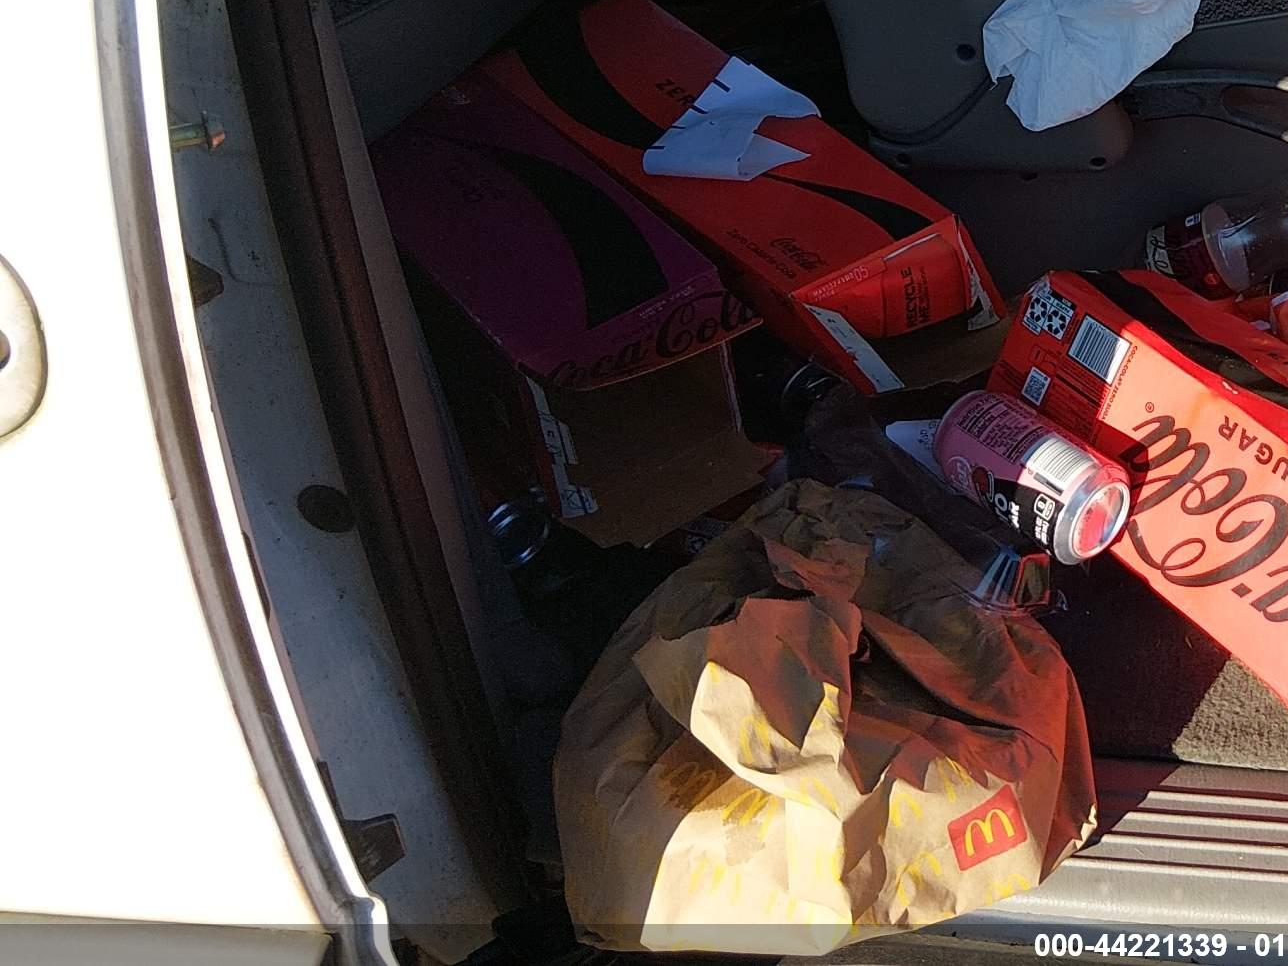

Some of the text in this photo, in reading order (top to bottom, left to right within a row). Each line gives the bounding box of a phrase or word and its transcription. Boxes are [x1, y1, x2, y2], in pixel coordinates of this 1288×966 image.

[654, 78, 694, 107] ZER
[900, 267, 920, 328] RECYCLE
[1101, 403, 1113, 420] SUGA
